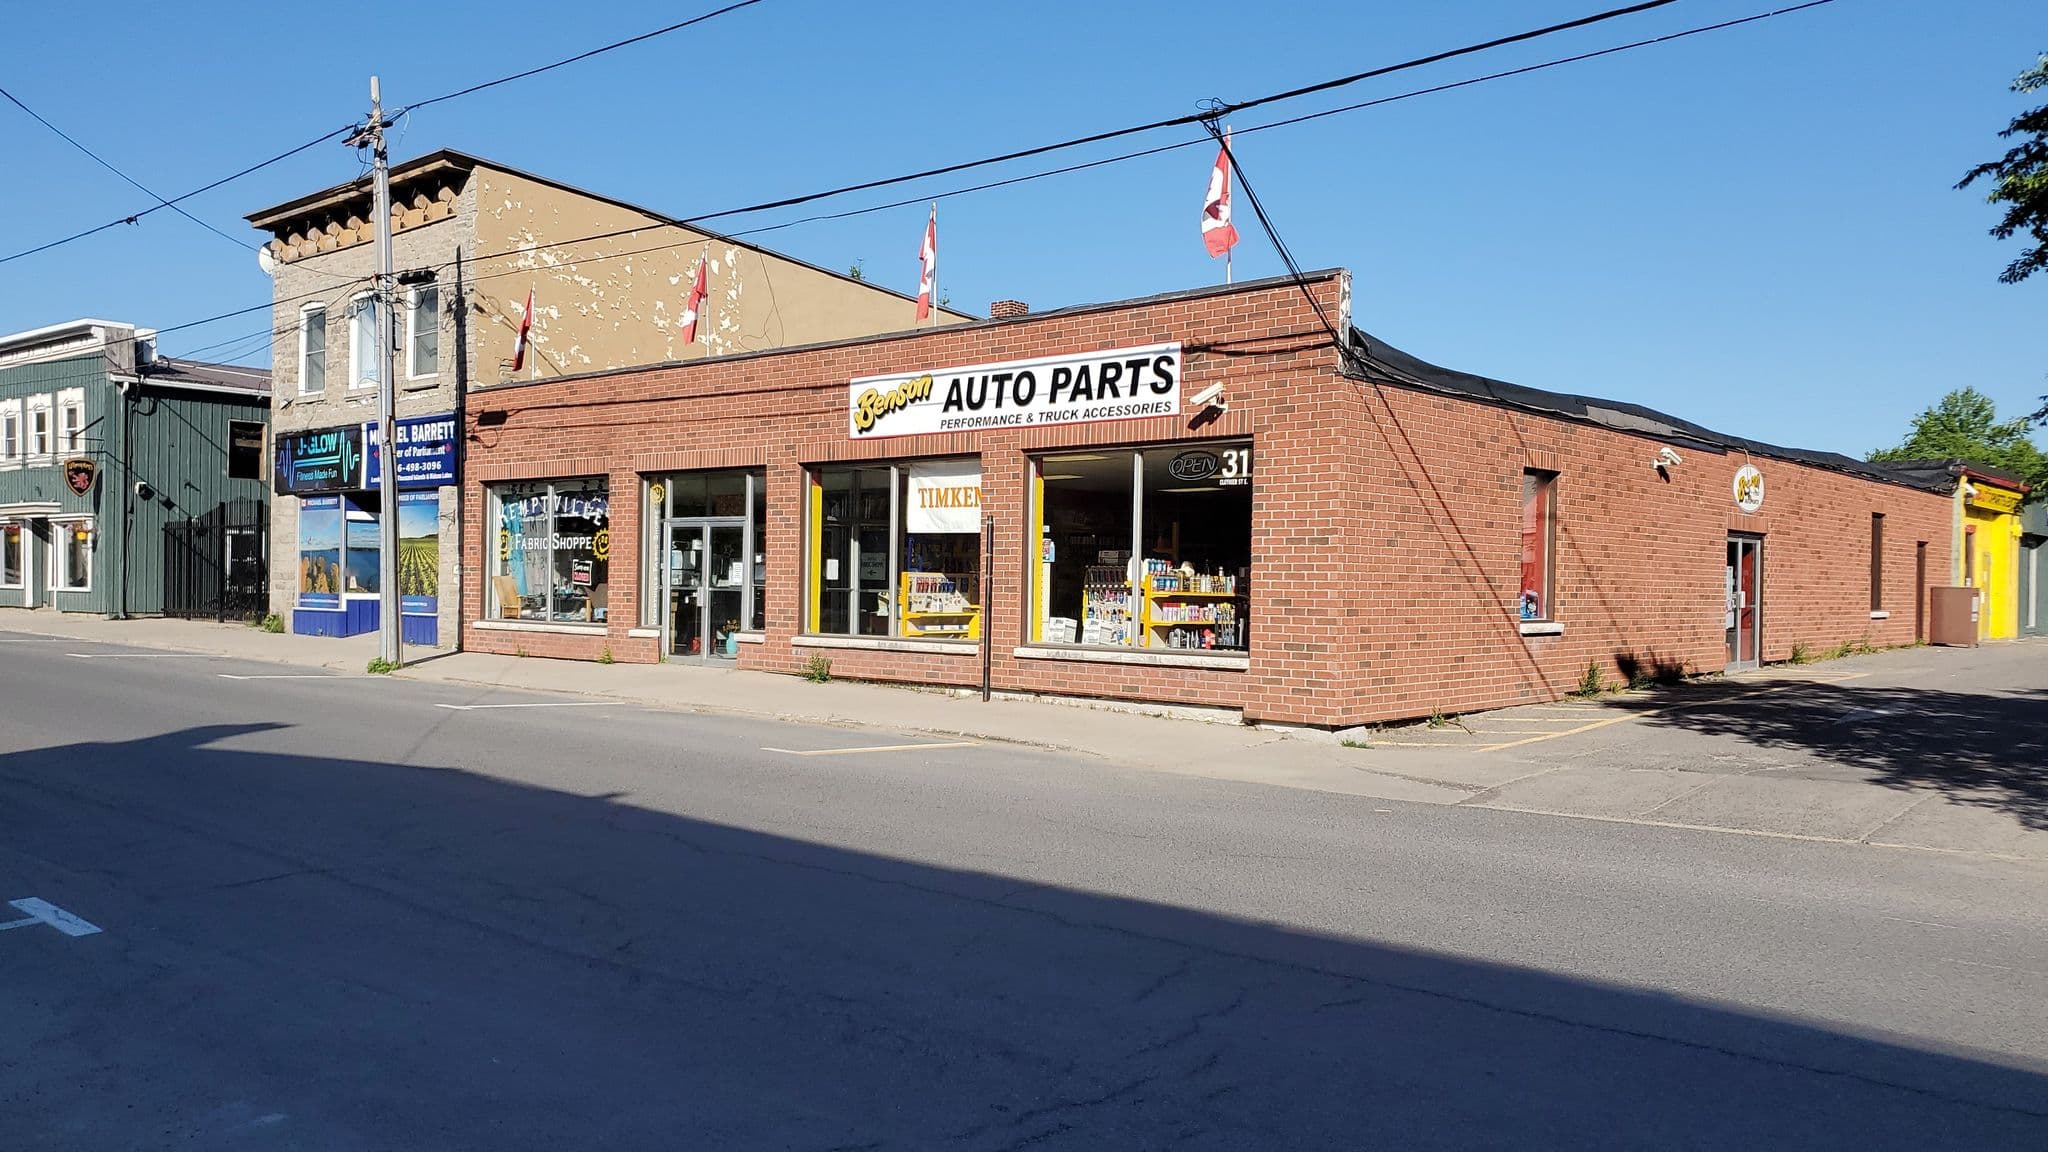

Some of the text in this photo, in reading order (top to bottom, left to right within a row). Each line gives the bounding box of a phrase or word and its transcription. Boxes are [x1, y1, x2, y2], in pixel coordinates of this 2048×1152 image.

[854, 356, 1175, 434] Benson AUTO PARTS
[940, 401, 1172, 429] PERFORMANCE & TRUCK ACCESSORIES
[412, 421, 455, 442] BARRETT
[298, 433, 337, 455] J-GLOW
[404, 446, 412, 456] of
[314, 469, 327, 479] Made
[328, 468, 337, 478] Fun
[1171, 458, 1216, 473] OPEN
[1222, 448, 1248, 478] 31
[918, 486, 982, 508] TIMKEN
[515, 533, 592, 549] FABRIC SHOPPE
